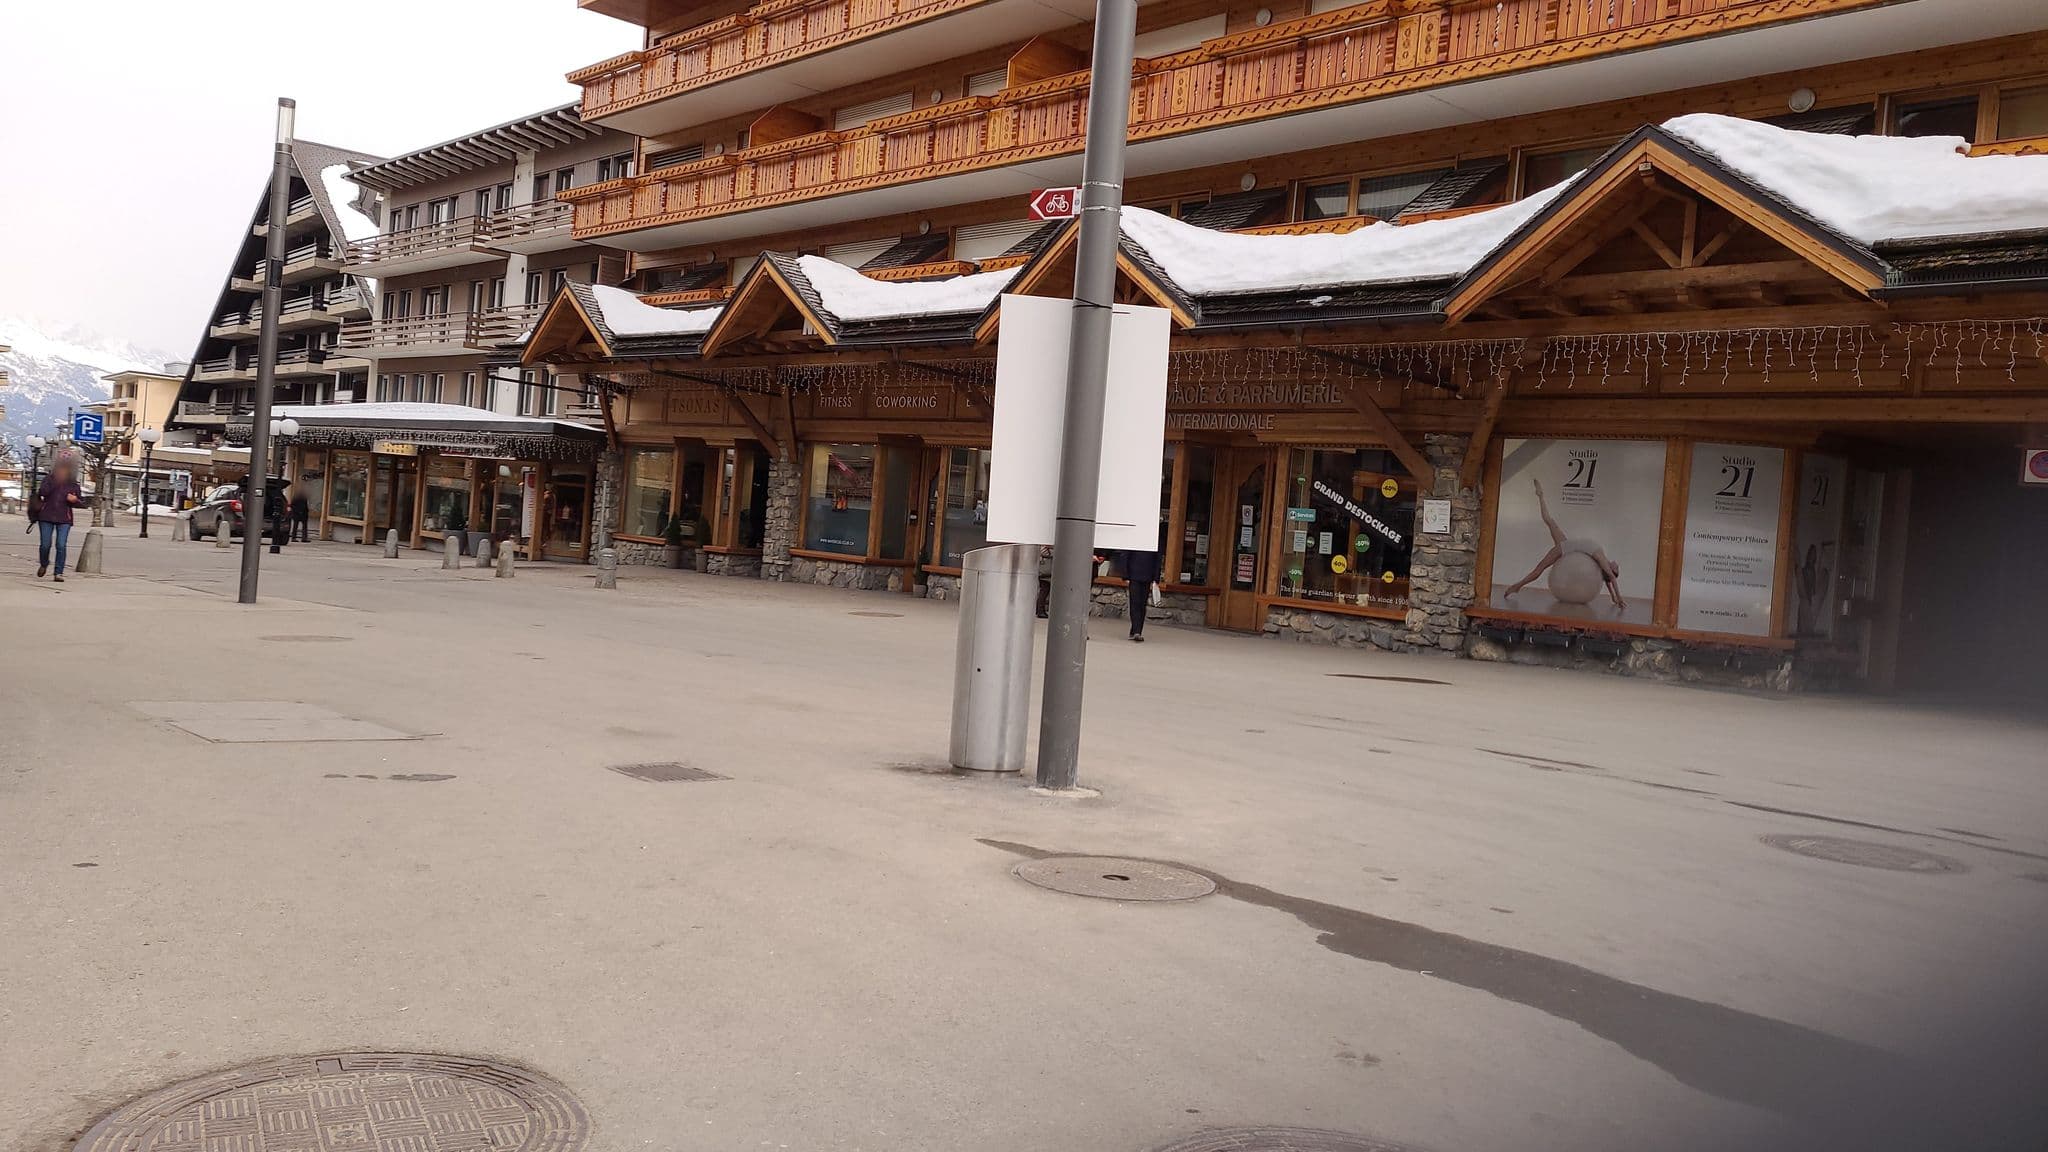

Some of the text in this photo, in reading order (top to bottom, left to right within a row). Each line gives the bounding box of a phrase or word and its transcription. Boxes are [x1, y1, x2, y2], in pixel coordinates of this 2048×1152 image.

[1215, 384, 1226, 404] &
[1231, 383, 1342, 404] PARFUMERIE
[820, 396, 852, 408] FITNESS
[876, 396, 937, 408] COWORKING
[82, 420, 94, 435] P
[1167, 413, 1275, 430] NTERNATIONALE
[1569, 449, 1598, 458] Studio
[1722, 455, 1756, 466] Studio
[1563, 458, 1597, 488] 21
[1715, 465, 1754, 498] 21
[1313, 480, 1344, 505] GRAND
[1344, 501, 1402, 544] DESTOCKAGE
[1308, 589, 1333, 597] guardian
